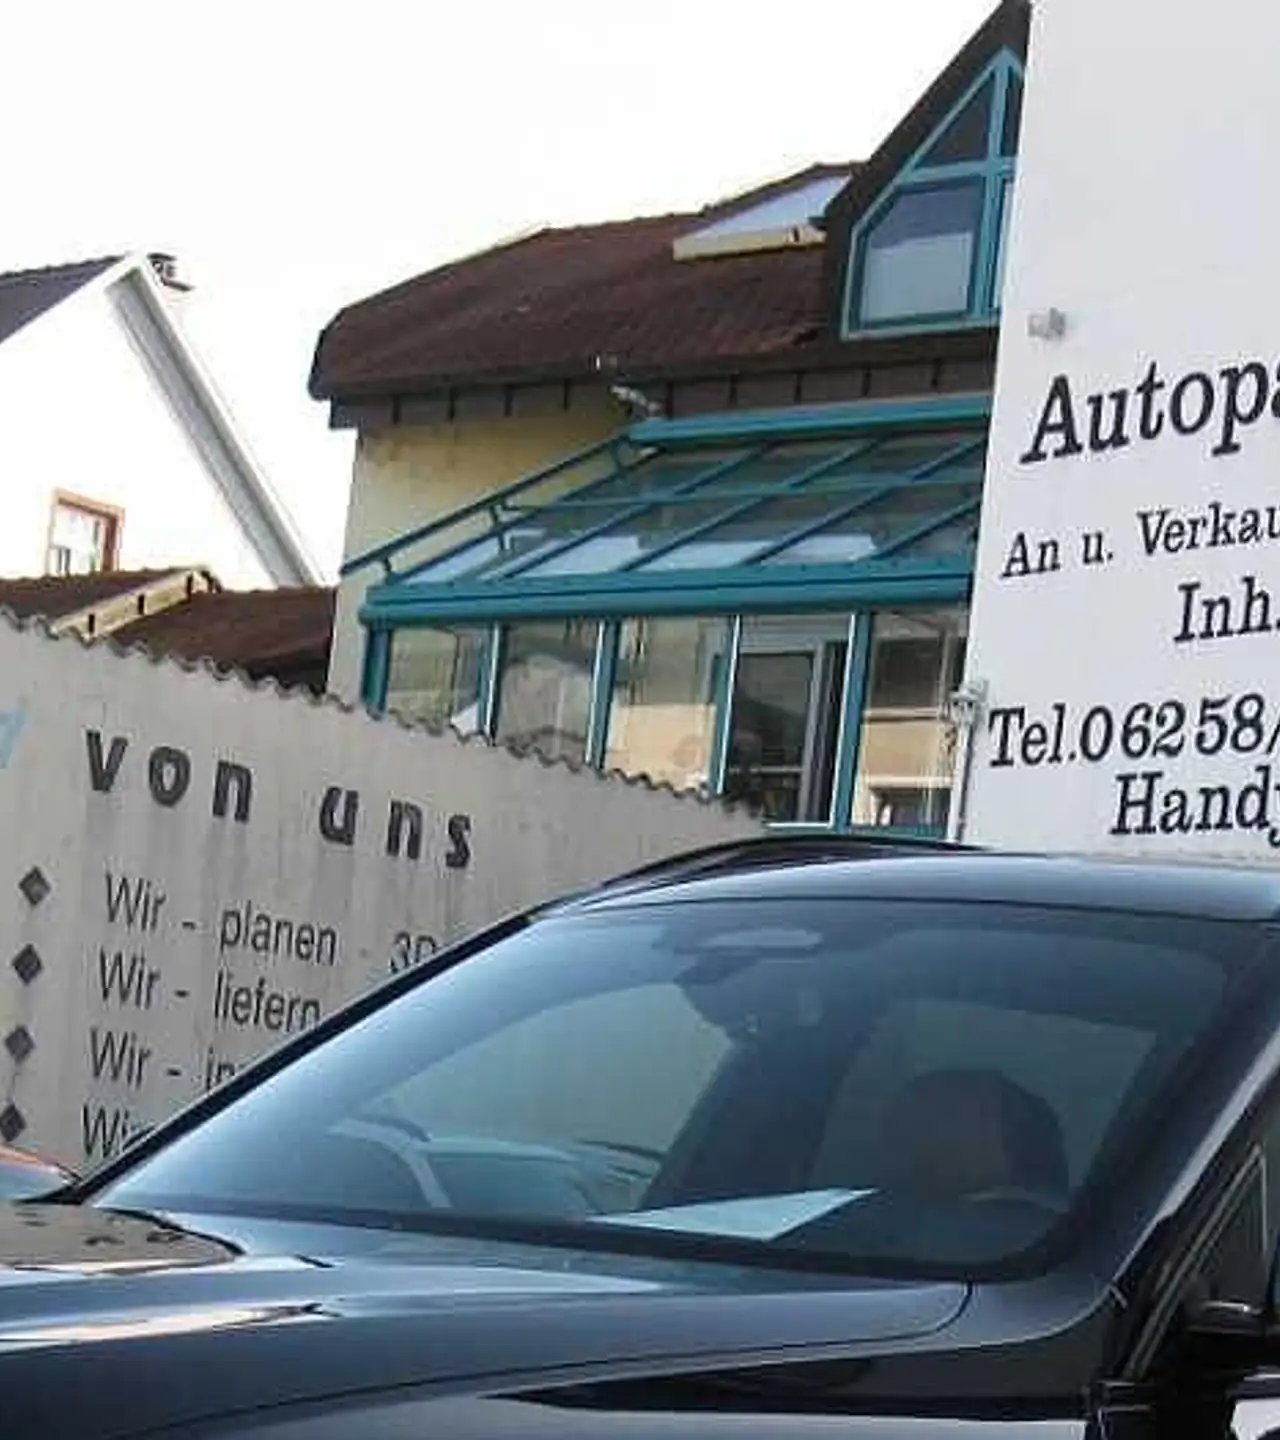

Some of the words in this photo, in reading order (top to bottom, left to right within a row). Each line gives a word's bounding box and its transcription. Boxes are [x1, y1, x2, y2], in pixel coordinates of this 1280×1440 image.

[1000, 532, 1061, 580] An
[1082, 532, 1114, 564] u.
[85, 730, 252, 823] von
[320, 786, 471, 869] uns
[105, 873, 167, 931] Wir
[220, 900, 337, 966] planen
[99, 948, 161, 1009] Wir
[214, 969, 320, 1032] liefern
[89, 1027, 151, 1089] Wir
